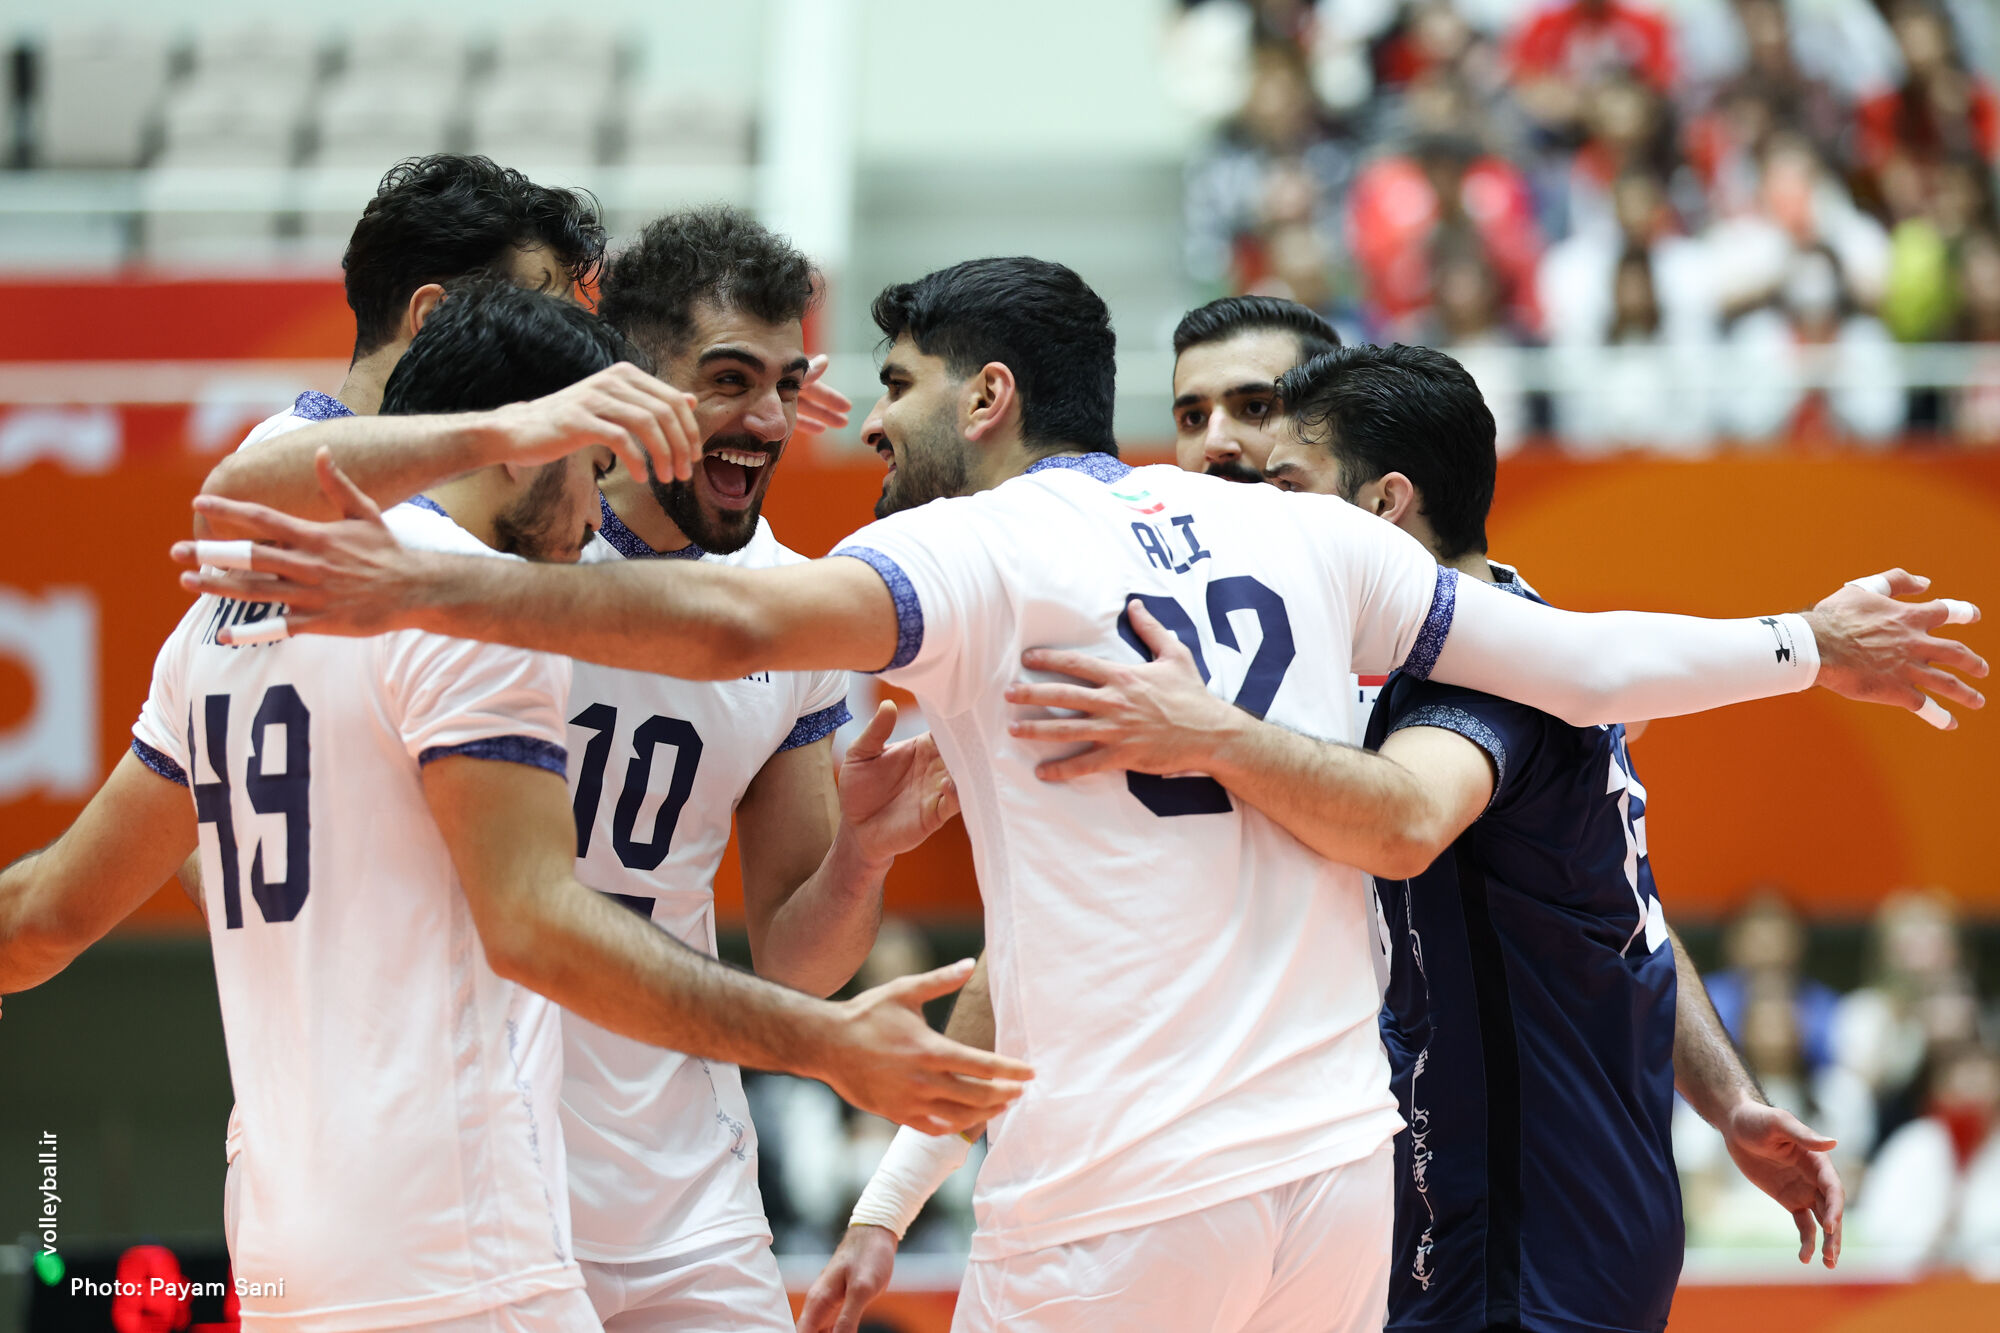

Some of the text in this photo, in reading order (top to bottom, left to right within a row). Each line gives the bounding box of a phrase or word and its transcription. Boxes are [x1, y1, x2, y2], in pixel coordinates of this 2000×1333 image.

[1131, 514, 1211, 574] ALI
[188, 684, 310, 929] 49
[568, 702, 704, 871] 10
